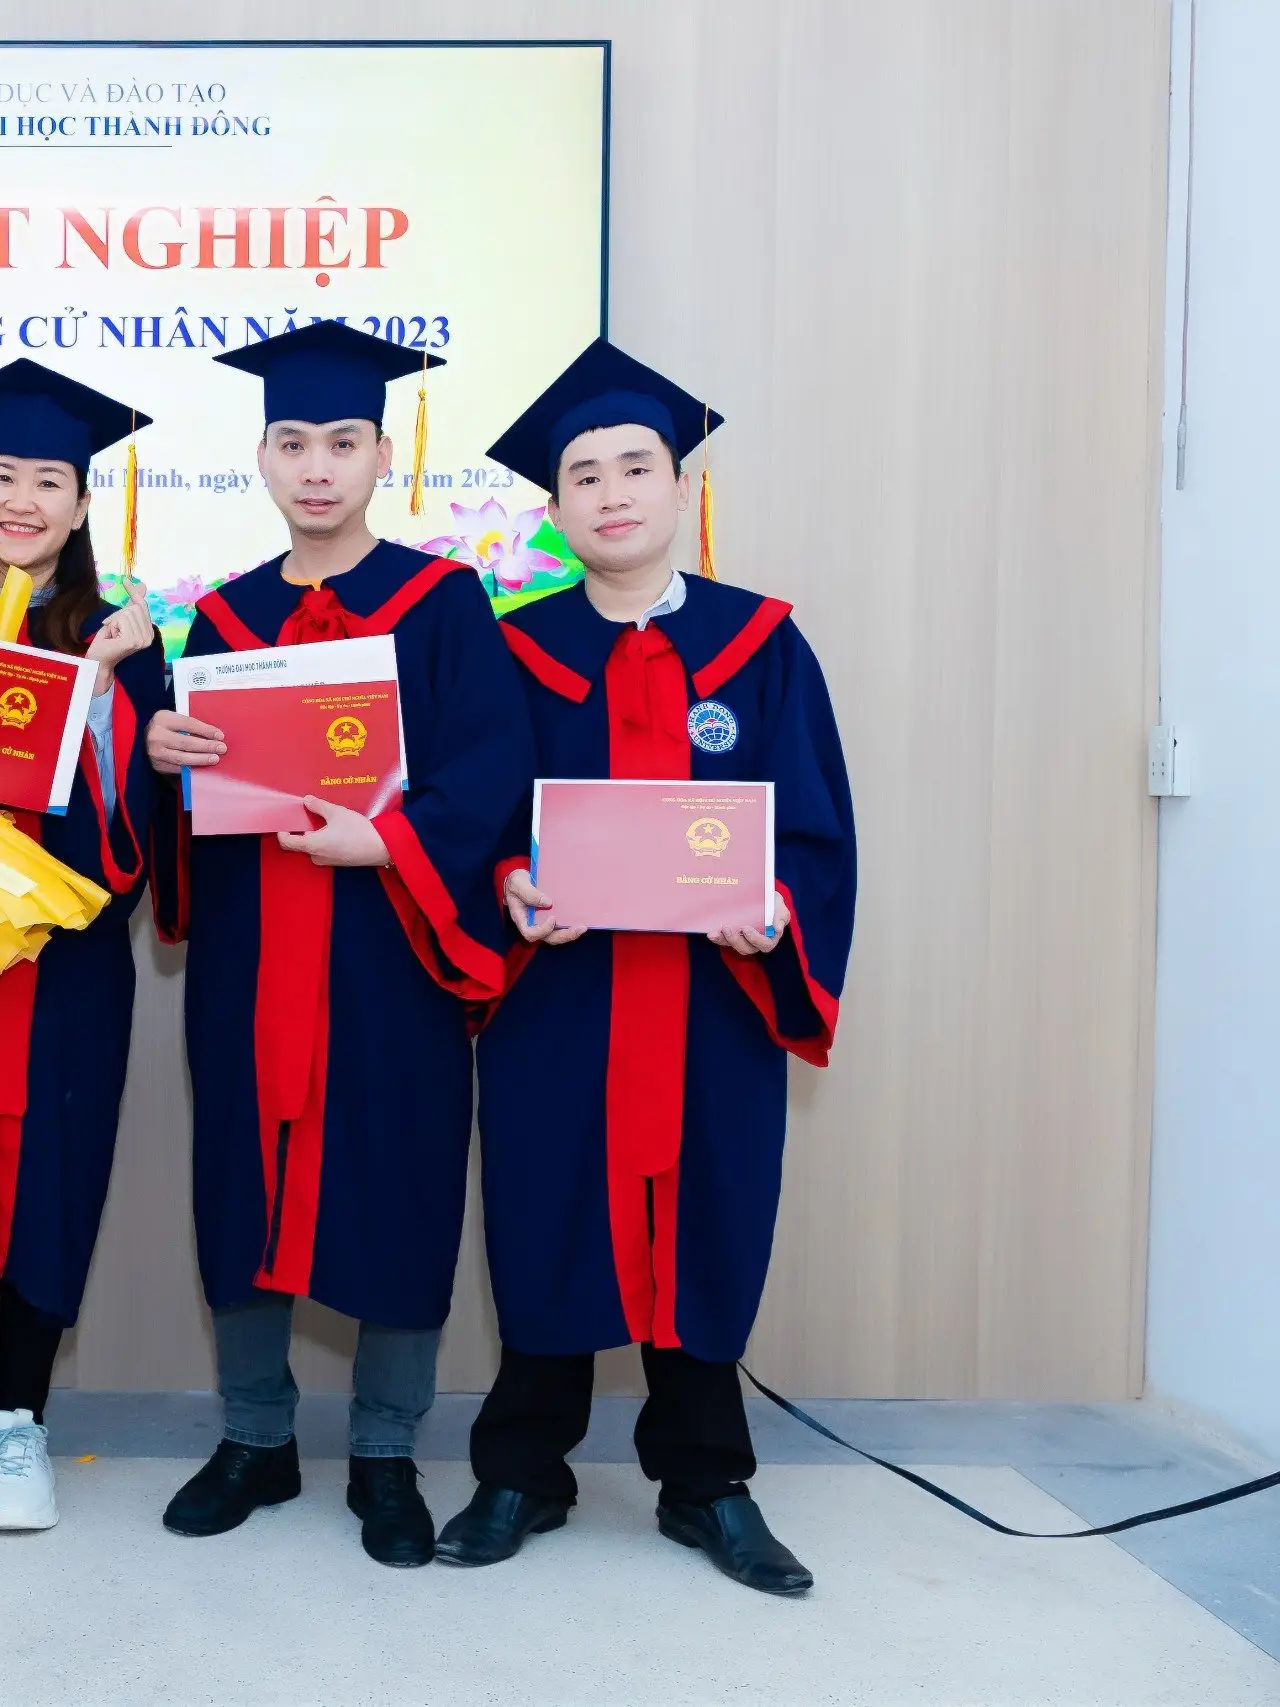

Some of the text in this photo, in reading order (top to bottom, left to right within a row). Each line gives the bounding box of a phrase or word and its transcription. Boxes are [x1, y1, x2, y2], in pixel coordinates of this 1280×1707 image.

[61, 77, 97, 103] VÀ
[106, 77, 164, 103] ĐÀO
[172, 83, 226, 107] TẠO
[17, 116, 76, 141] HỌC
[84, 110, 183, 136] THÀNH
[191, 109, 272, 136] ĐÔNG
[55, 195, 410, 288] NGHIỆP
[19, 307, 88, 349] CỬ
[100, 306, 230, 348] NHÂN
[363, 316, 450, 348] 2023
[87, 468, 114, 488] hí
[198, 469, 253, 493] ngày
[376, 468, 394, 488] 2
[461, 468, 514, 488] 2023
[694, 732, 736, 751] UNIVERSITY
